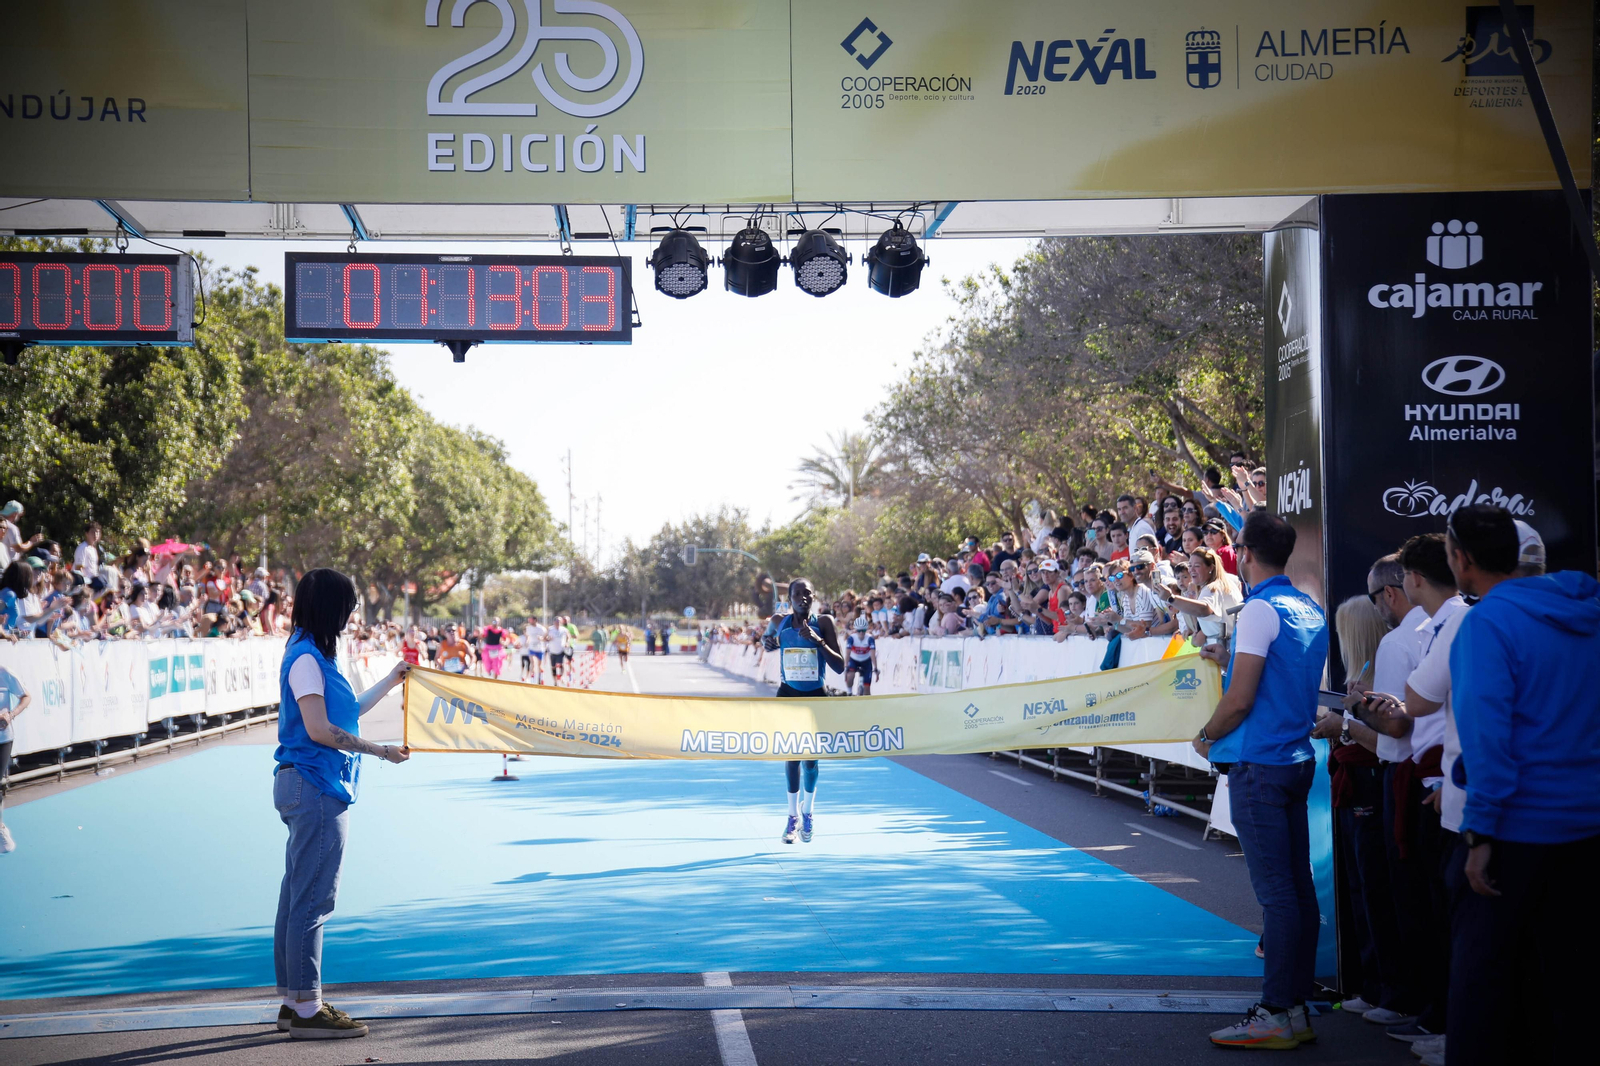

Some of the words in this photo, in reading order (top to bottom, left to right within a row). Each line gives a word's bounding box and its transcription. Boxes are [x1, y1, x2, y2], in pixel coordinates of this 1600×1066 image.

[1254, 20, 1411, 57] ALMERÍA
[425, 0, 645, 118] 25
[1254, 62, 1334, 81] CIUDAD
[841, 74, 972, 92] COOPERACIÓN
[1016, 85, 1046, 95] 2020
[1454, 86, 1518, 96] DEPORTES
[841, 94, 885, 109] 2005
[888, 93, 921, 101] Deporte,
[923, 93, 940, 101] ocio
[427, 124, 646, 172] EDICIÓN
[1367, 273, 1543, 318] cajamar
[1453, 309, 1488, 320] CAJA
[1493, 309, 1538, 320] RURAL
[1404, 403, 1520, 421] HYUNDAI
[1409, 425, 1517, 441] Almerialva
[793, 653, 808, 664] 16
[515, 713, 558, 728] Medio
[563, 718, 623, 734] Maratón
[579, 732, 622, 748] 2024
[681, 729, 768, 754] MEDIO
[772, 725, 904, 754] MARATÓN
